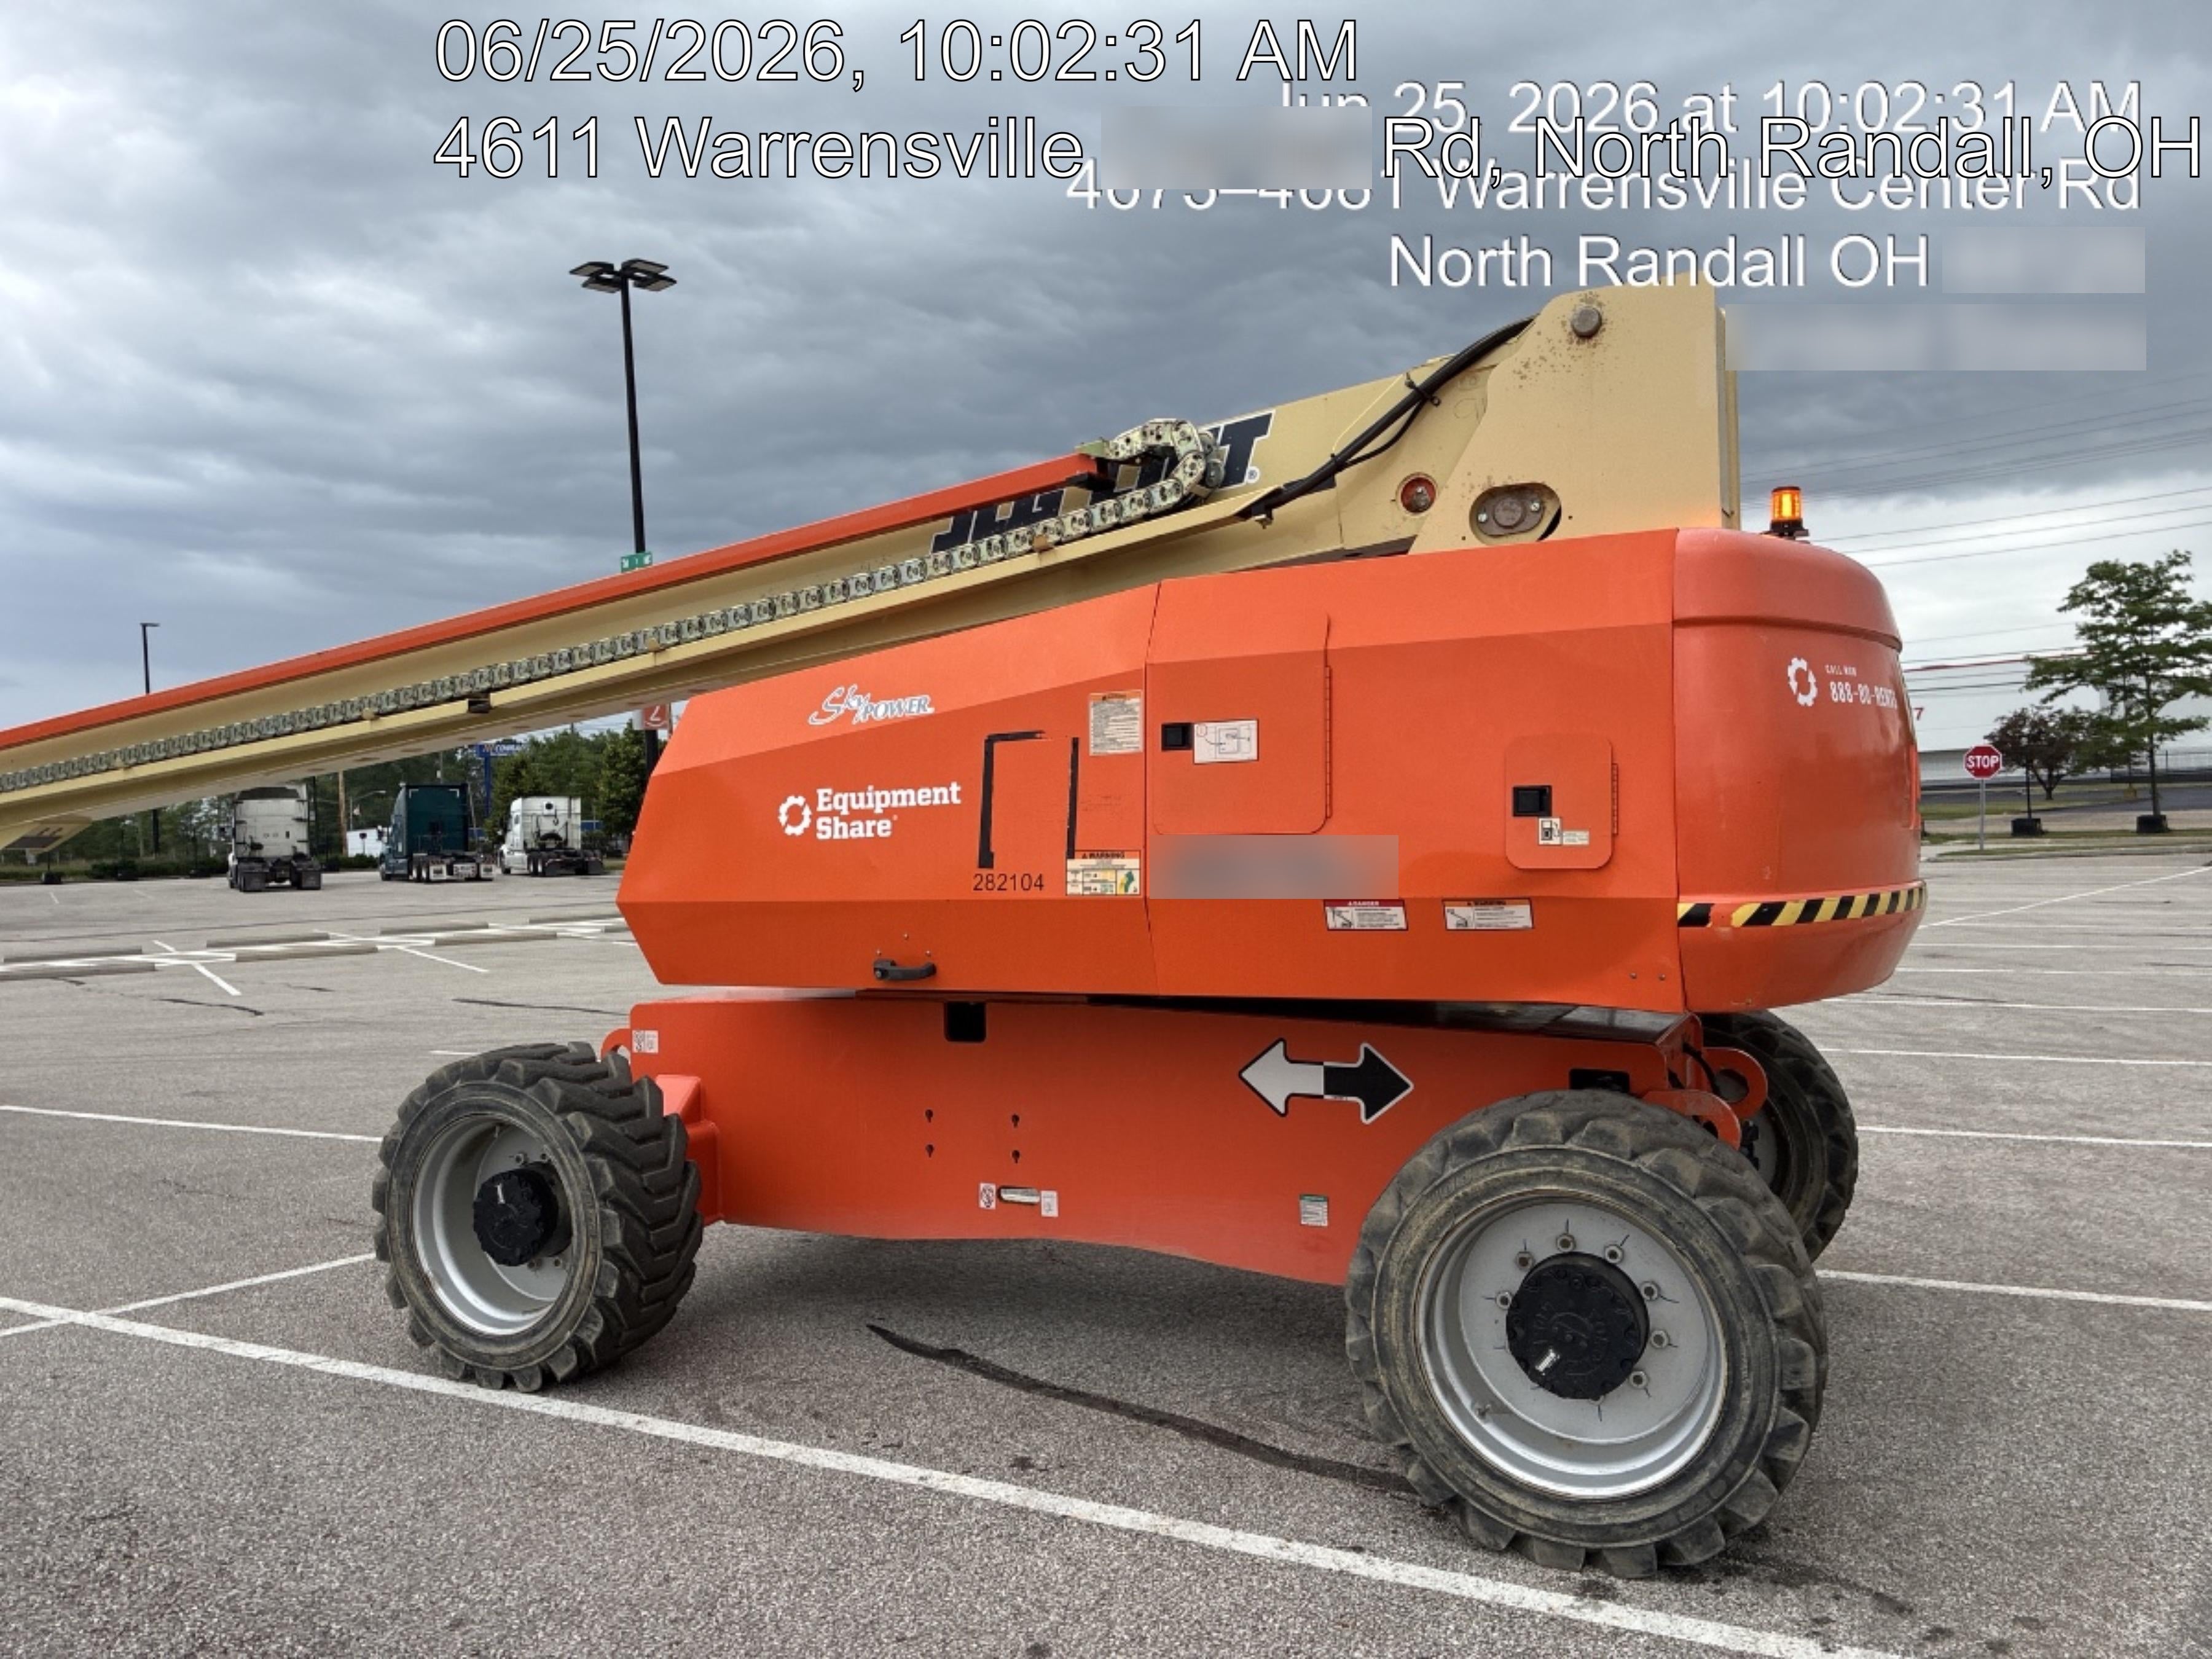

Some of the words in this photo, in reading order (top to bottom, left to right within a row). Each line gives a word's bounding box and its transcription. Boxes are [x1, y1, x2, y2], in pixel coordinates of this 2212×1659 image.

[1966, 755, 1999, 769] STOP
[815, 781, 962, 816] Equipment
[815, 815, 892, 840] Share
[973, 873, 1045, 892] 282104
